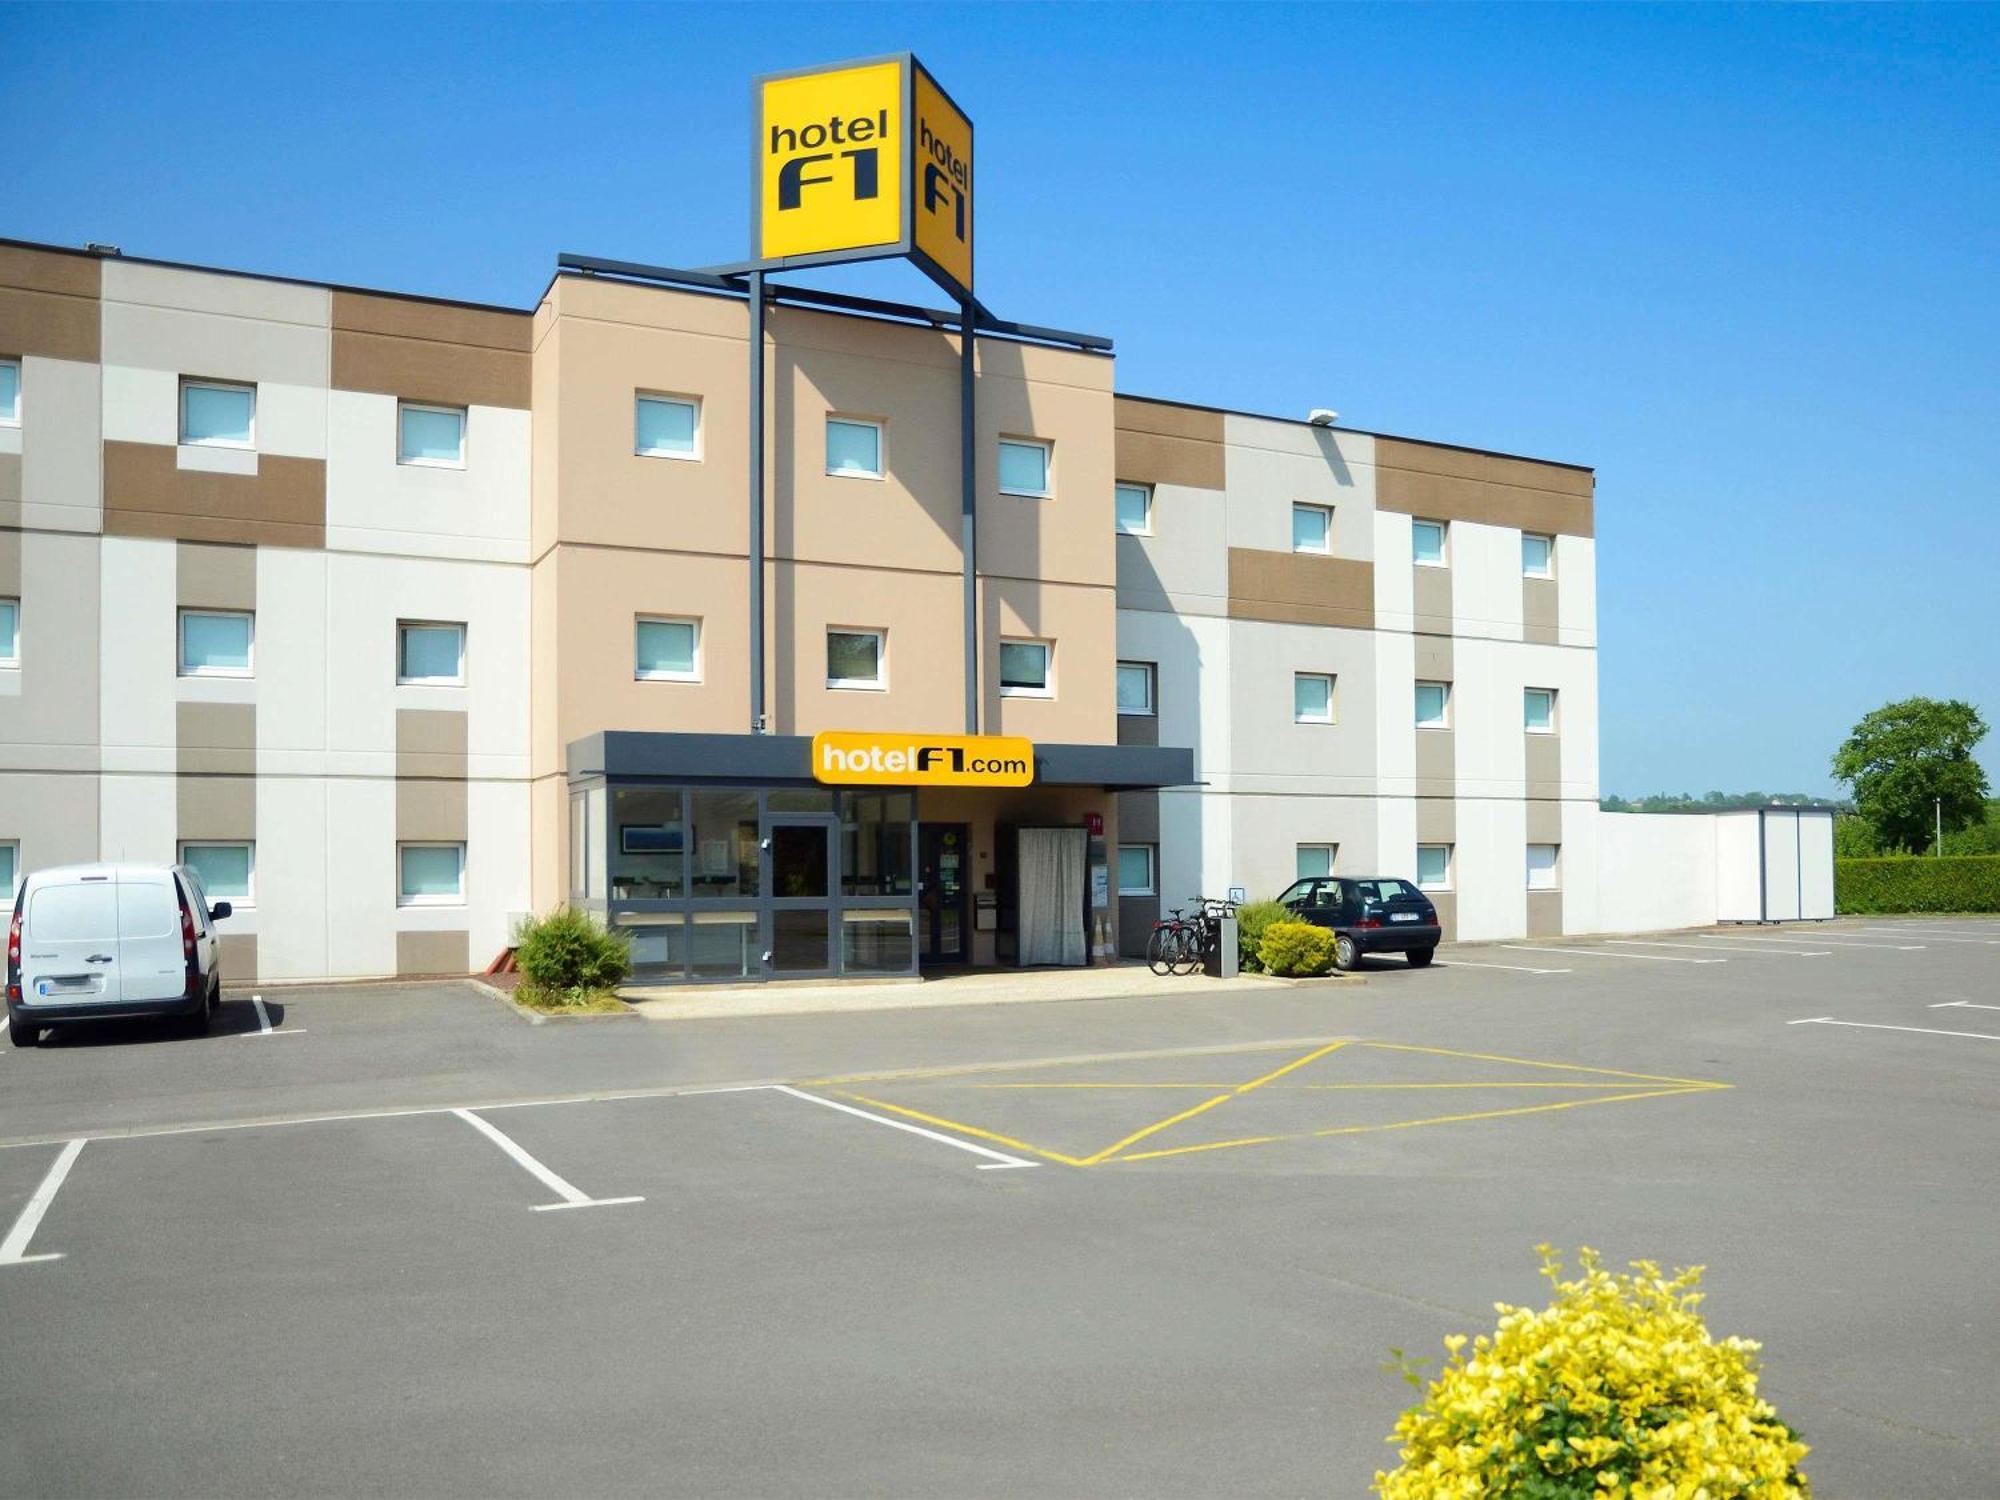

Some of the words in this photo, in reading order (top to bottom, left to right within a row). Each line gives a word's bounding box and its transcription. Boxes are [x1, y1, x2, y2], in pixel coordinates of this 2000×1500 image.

[771, 109, 887, 154] hotel
[920, 117, 967, 190] hotel
[778, 147, 878, 211] F1
[924, 161, 965, 243] F1
[823, 744, 1026, 774] hotelF1.com
